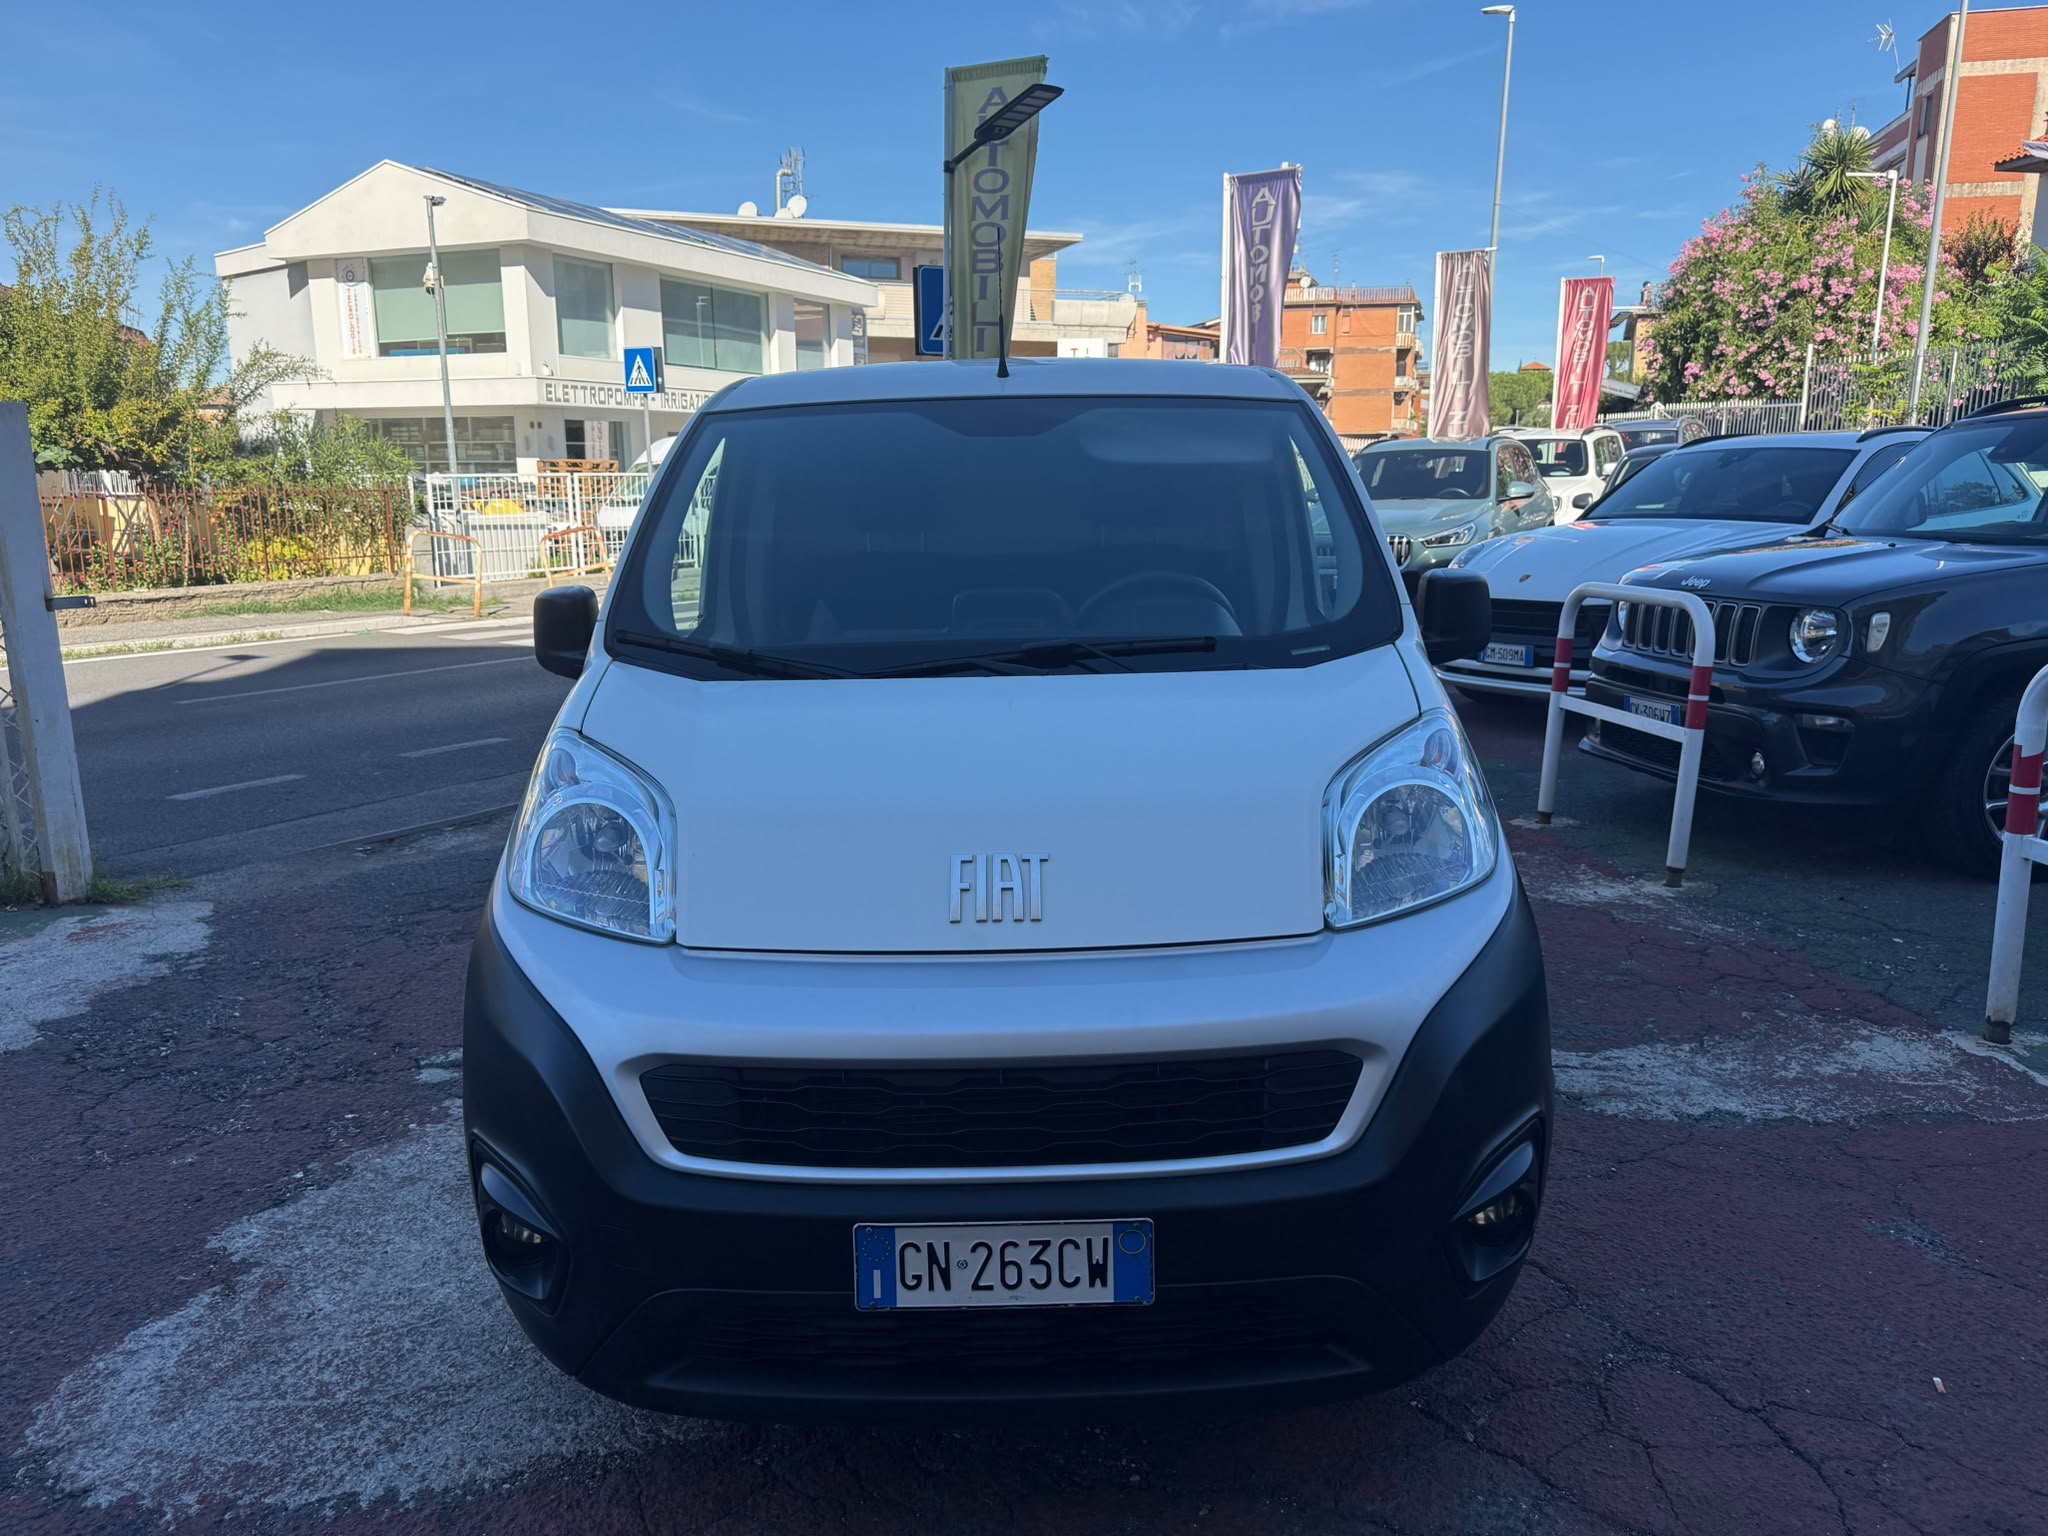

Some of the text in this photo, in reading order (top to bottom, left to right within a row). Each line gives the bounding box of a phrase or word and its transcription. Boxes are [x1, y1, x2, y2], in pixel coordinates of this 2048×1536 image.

[971, 86, 1010, 352] ATOMOBILI
[1681, 576, 1711, 589] Jeep
[949, 853, 1049, 923] FIAT
[899, 1240, 951, 1292] GN
[970, 1237, 1109, 1292] 263CW
